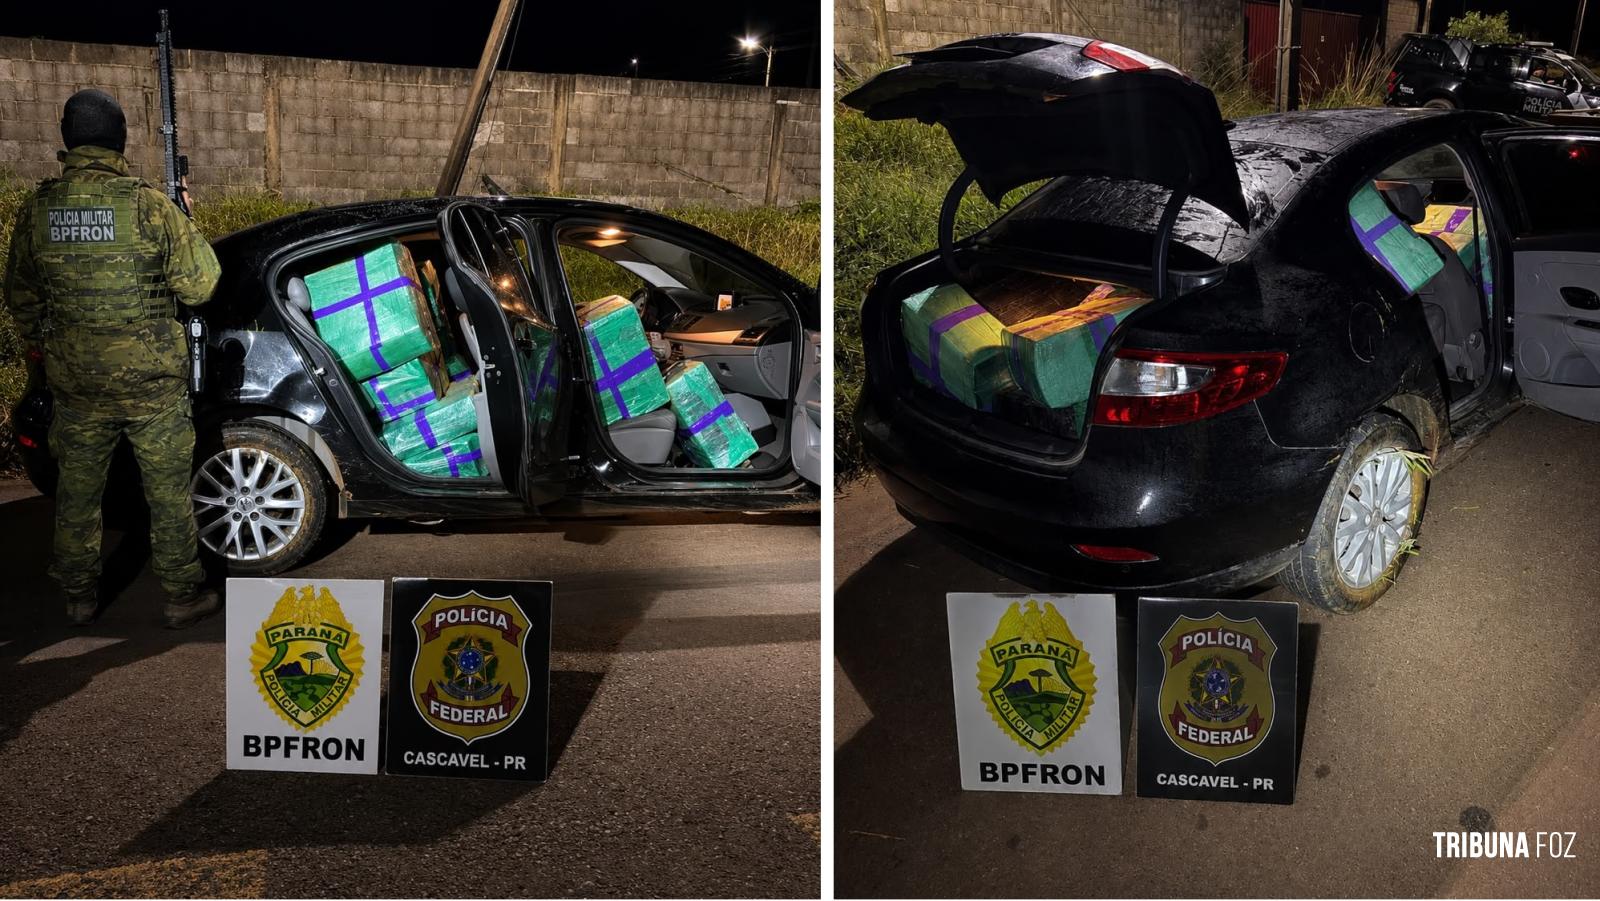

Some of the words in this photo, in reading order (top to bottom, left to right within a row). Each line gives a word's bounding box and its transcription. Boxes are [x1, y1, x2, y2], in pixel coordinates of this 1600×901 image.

[1522, 104, 1553, 115] MILITA
[1524, 97, 1562, 109] POLÍCIA
[81, 210, 114, 226] MILITAR
[50, 226, 115, 241] BPFRON
[434, 608, 509, 630] POLÍCIA
[270, 627, 344, 644] PARANÁ
[1182, 628, 1253, 653] POLÍCIA
[995, 643, 1073, 662] PARANÁ
[265, 673, 301, 718] POLÍCIA
[310, 676, 348, 718] MILITAR
[430, 700, 508, 723] FEDERAL
[995, 694, 1034, 739] POLÍCIA
[1043, 696, 1080, 740] MILITAR
[1178, 721, 1253, 744] FEDERAL
[243, 735, 365, 761] BPFRON
[403, 751, 490, 768] CASCAVEL
[504, 755, 526, 770] PR
[979, 762, 1105, 786] BPFRON
[1156, 773, 1239, 788] CASCAVEL
[1252, 778, 1274, 791] PR
